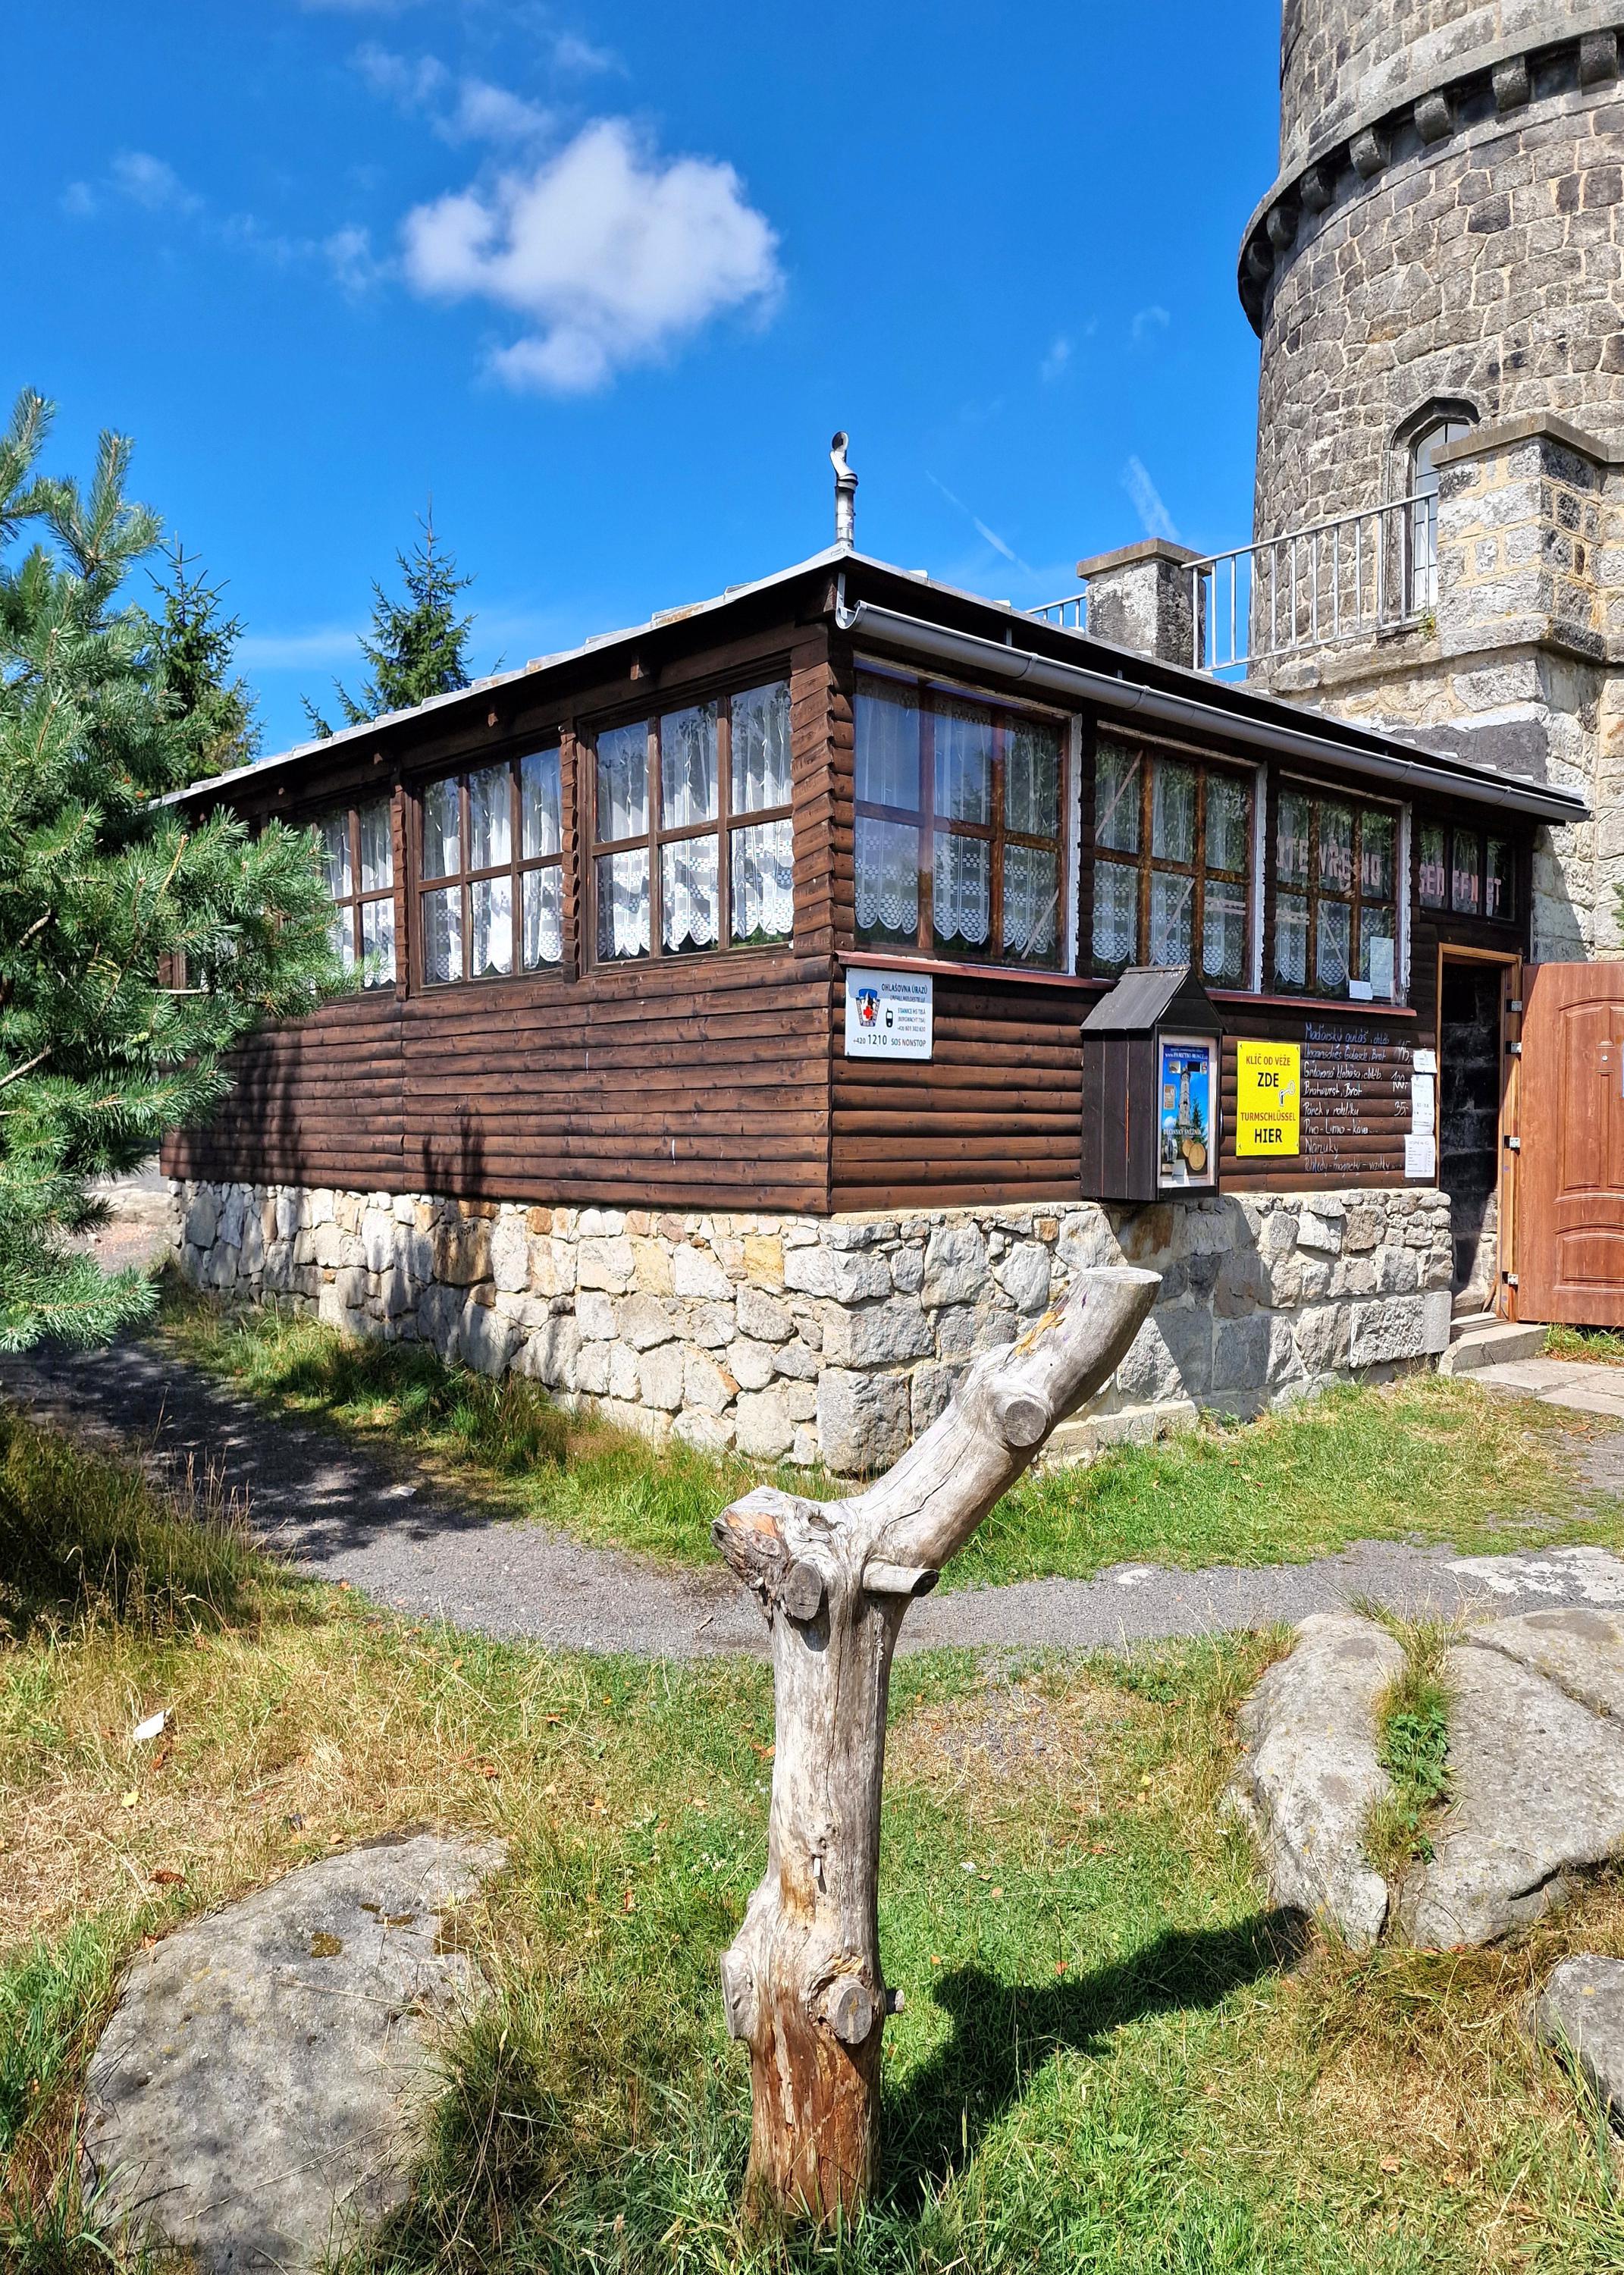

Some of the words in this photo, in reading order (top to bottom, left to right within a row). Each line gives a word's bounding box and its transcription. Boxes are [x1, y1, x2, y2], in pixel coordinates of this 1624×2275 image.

[882, 983, 911, 993] OHLAŠOVNA
[911, 984, 928, 994] ÚRAZŮ
[867, 1034, 887, 1045] 1210
[891, 1037, 901, 1046] SOS
[902, 1039, 926, 1047] NONSTOP
[1246, 1053, 1262, 1065] KLÍČ
[1264, 1056, 1273, 1065] OD
[1257, 1072, 1279, 1087] ZDE
[1343, 1082, 1362, 1098] Brot
[1240, 1110, 1296, 1122] TURMSCHLÜSSEL
[1325, 1108, 1330, 1116] v
[1254, 1128, 1283, 1144] HIER
[1305, 1138, 1339, 1159] Nanuky
